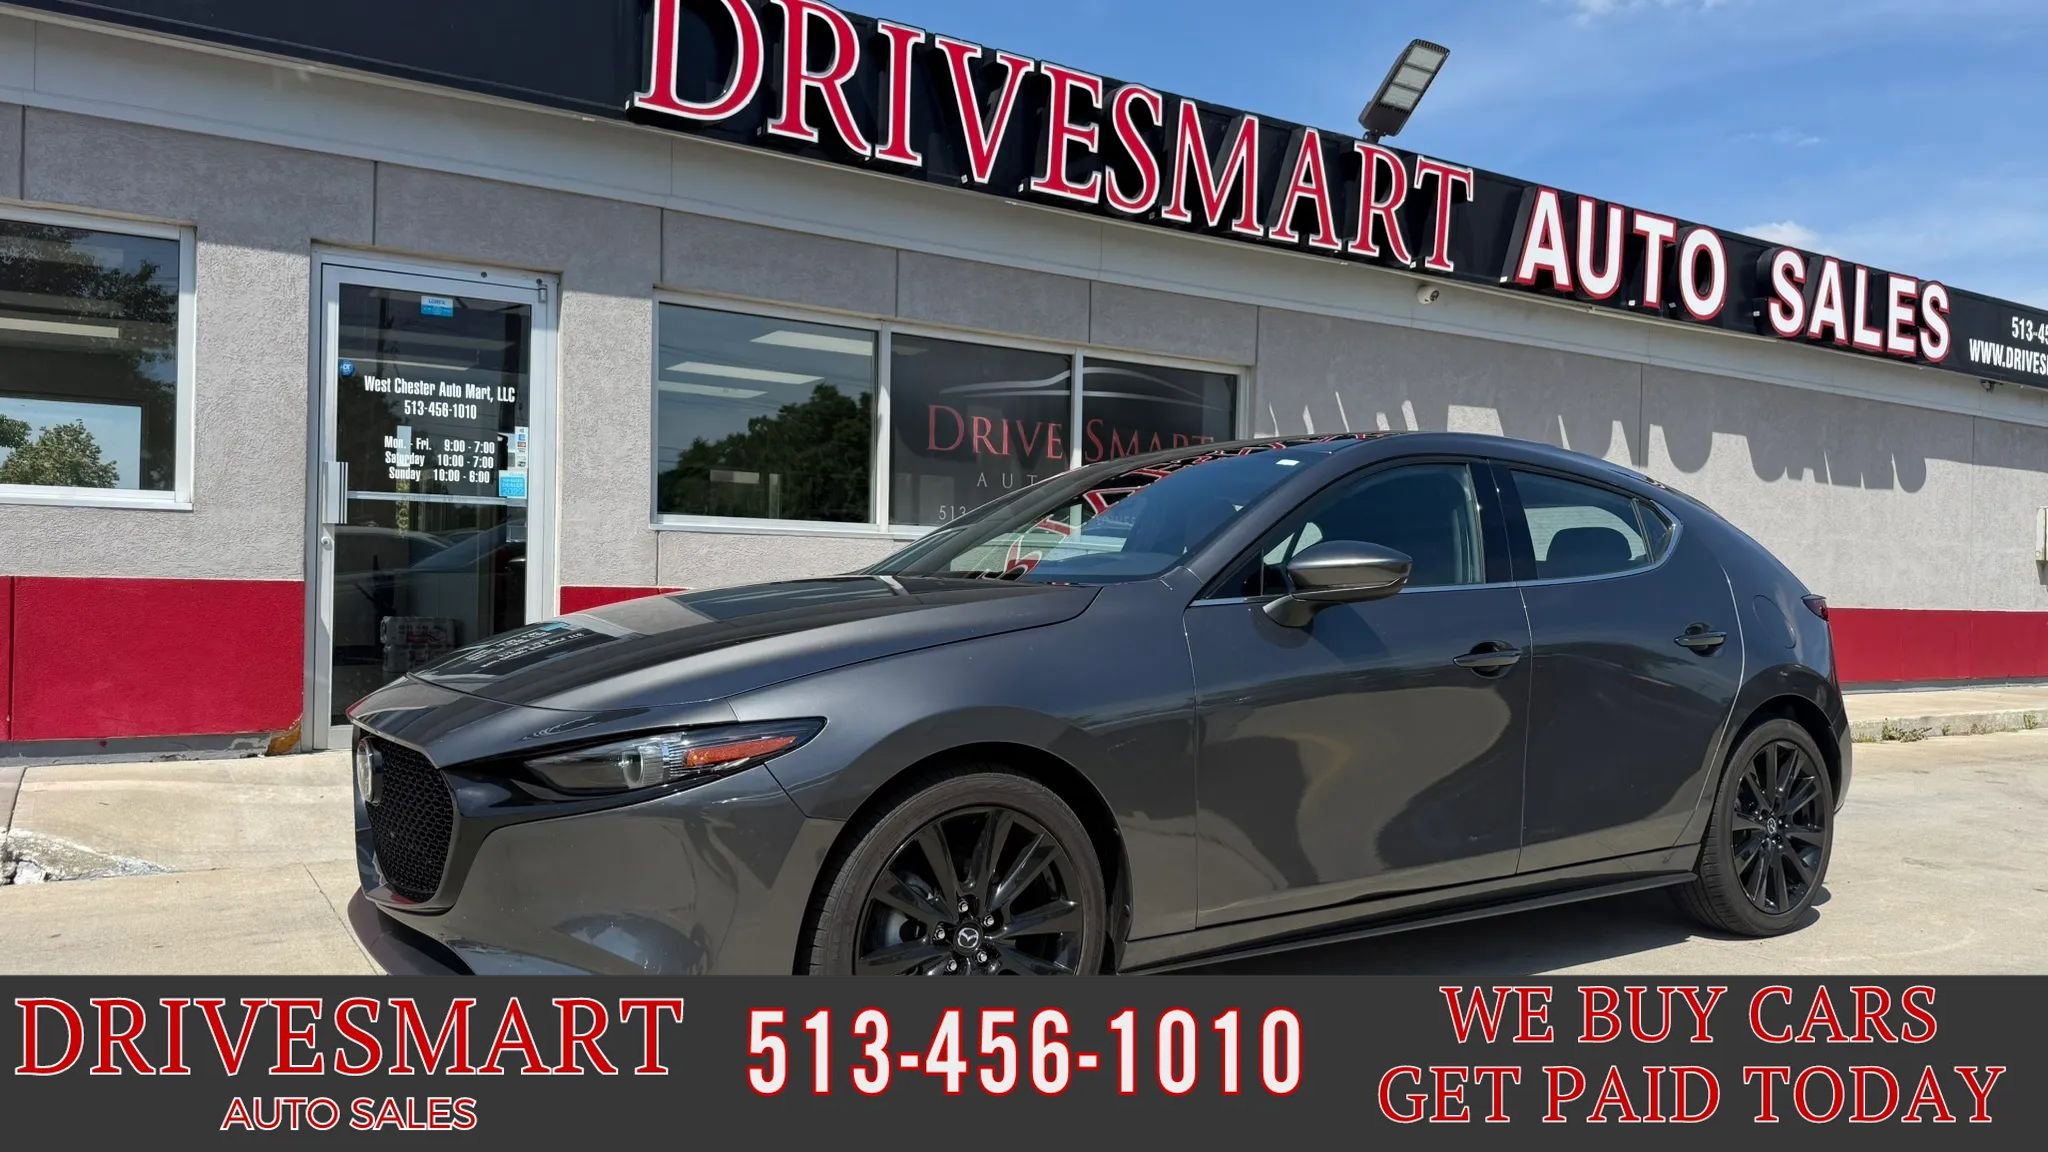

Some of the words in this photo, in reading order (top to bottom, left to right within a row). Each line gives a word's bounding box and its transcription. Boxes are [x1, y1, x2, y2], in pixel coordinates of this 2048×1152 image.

[634, 0, 1474, 272] DRIVESMART
[1514, 186, 1728, 321] AUTO
[1767, 247, 1951, 364] SALES
[1969, 338, 2048, 376] WWW.DRIVES
[364, 375, 391, 393] West
[394, 377, 436, 396] Chester
[439, 381, 462, 398] Auto
[465, 383, 494, 403] Mart,
[497, 386, 516, 403] LLC
[404, 399, 477, 420] 513-456-1010
[927, 404, 1064, 460] DRIVE
[384, 435, 407, 449] Mon.
[416, 437, 432, 450] Fri.
[444, 439, 465, 453] 9:00
[473, 440, 495, 454] 7:00
[384, 450, 425, 467] Saturday
[437, 453, 464, 467] 10:00
[472, 455, 494, 469] 7:00
[388, 466, 421, 482] Sunday
[433, 468, 460, 482] 10:00
[469, 470, 490, 483] 6:00
